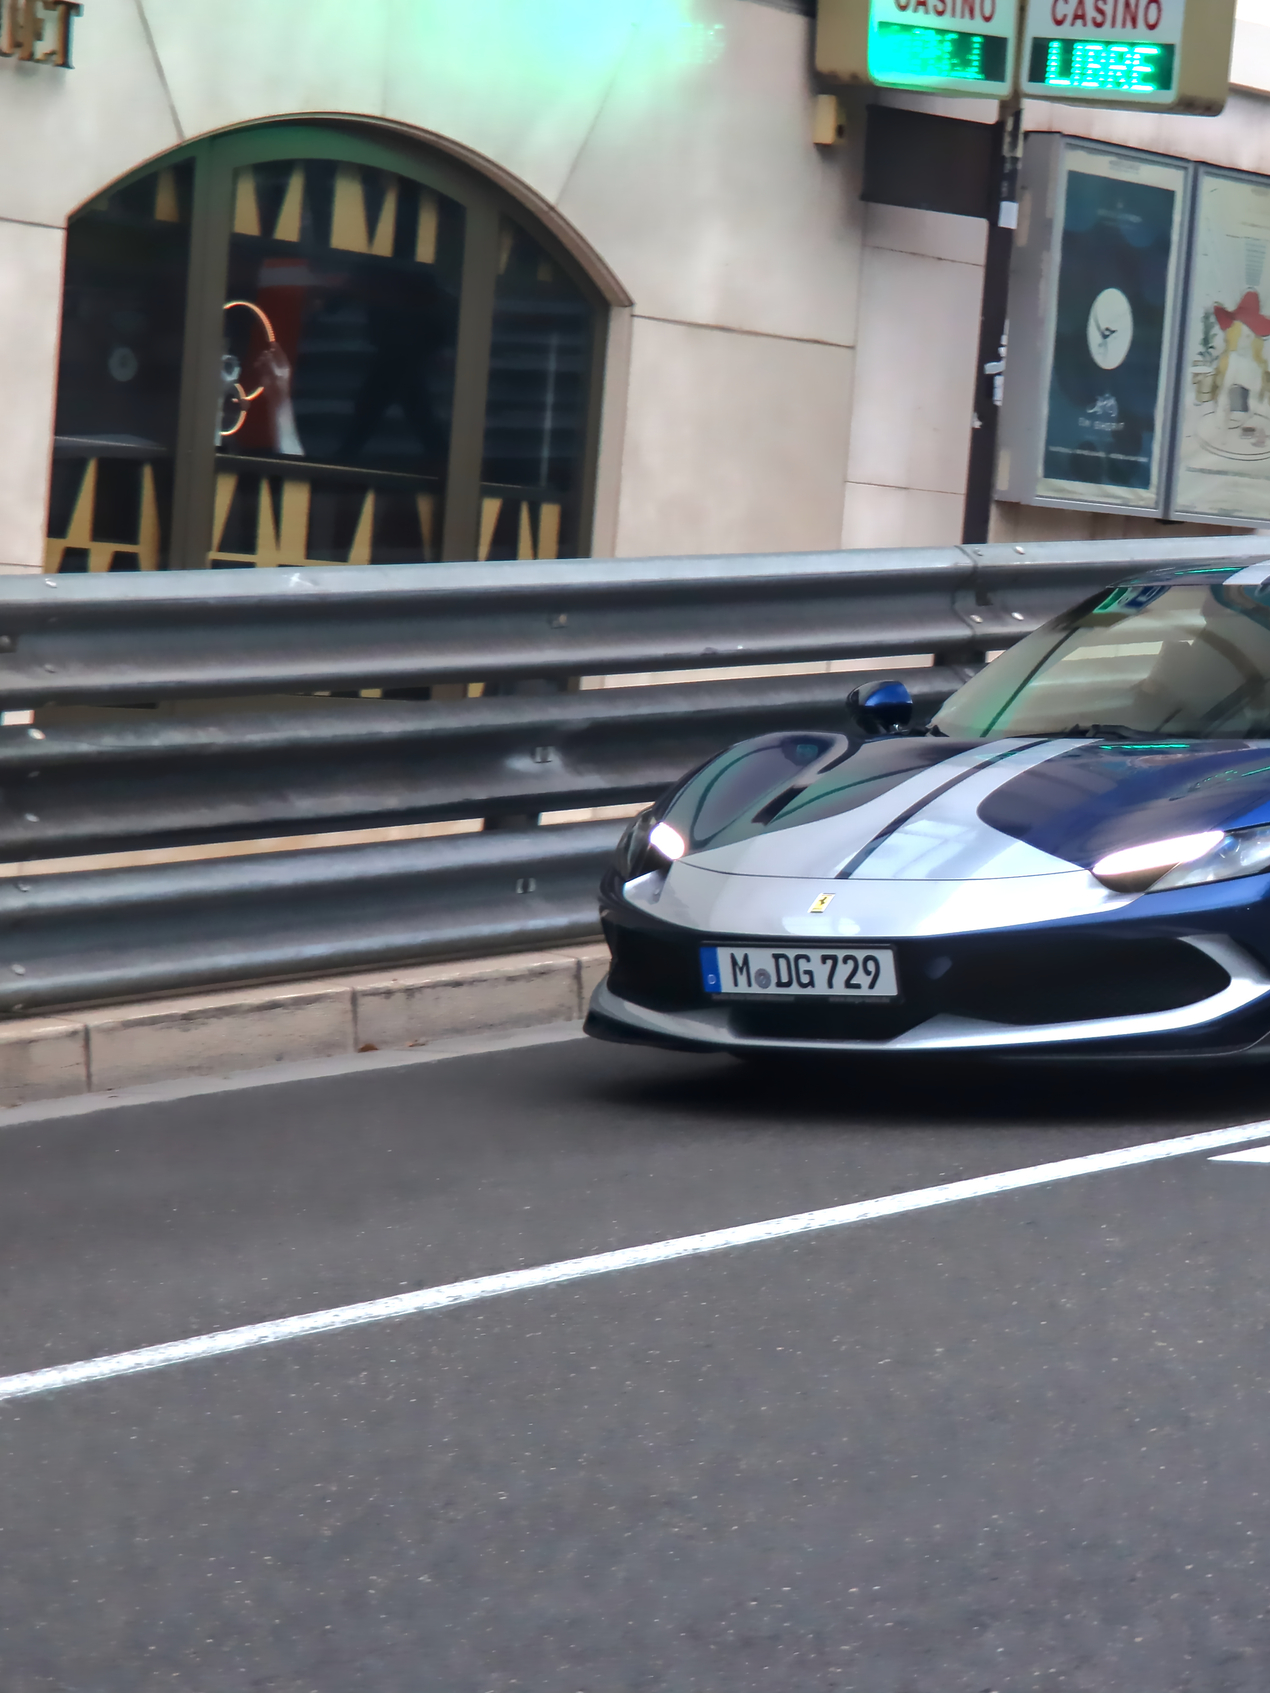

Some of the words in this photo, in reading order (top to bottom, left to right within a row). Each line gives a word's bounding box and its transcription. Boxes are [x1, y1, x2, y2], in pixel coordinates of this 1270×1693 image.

[1051, 0, 1162, 31] CASINO
[1045, 40, 1161, 93] LIBRE
[820, 954, 881, 990] 729
